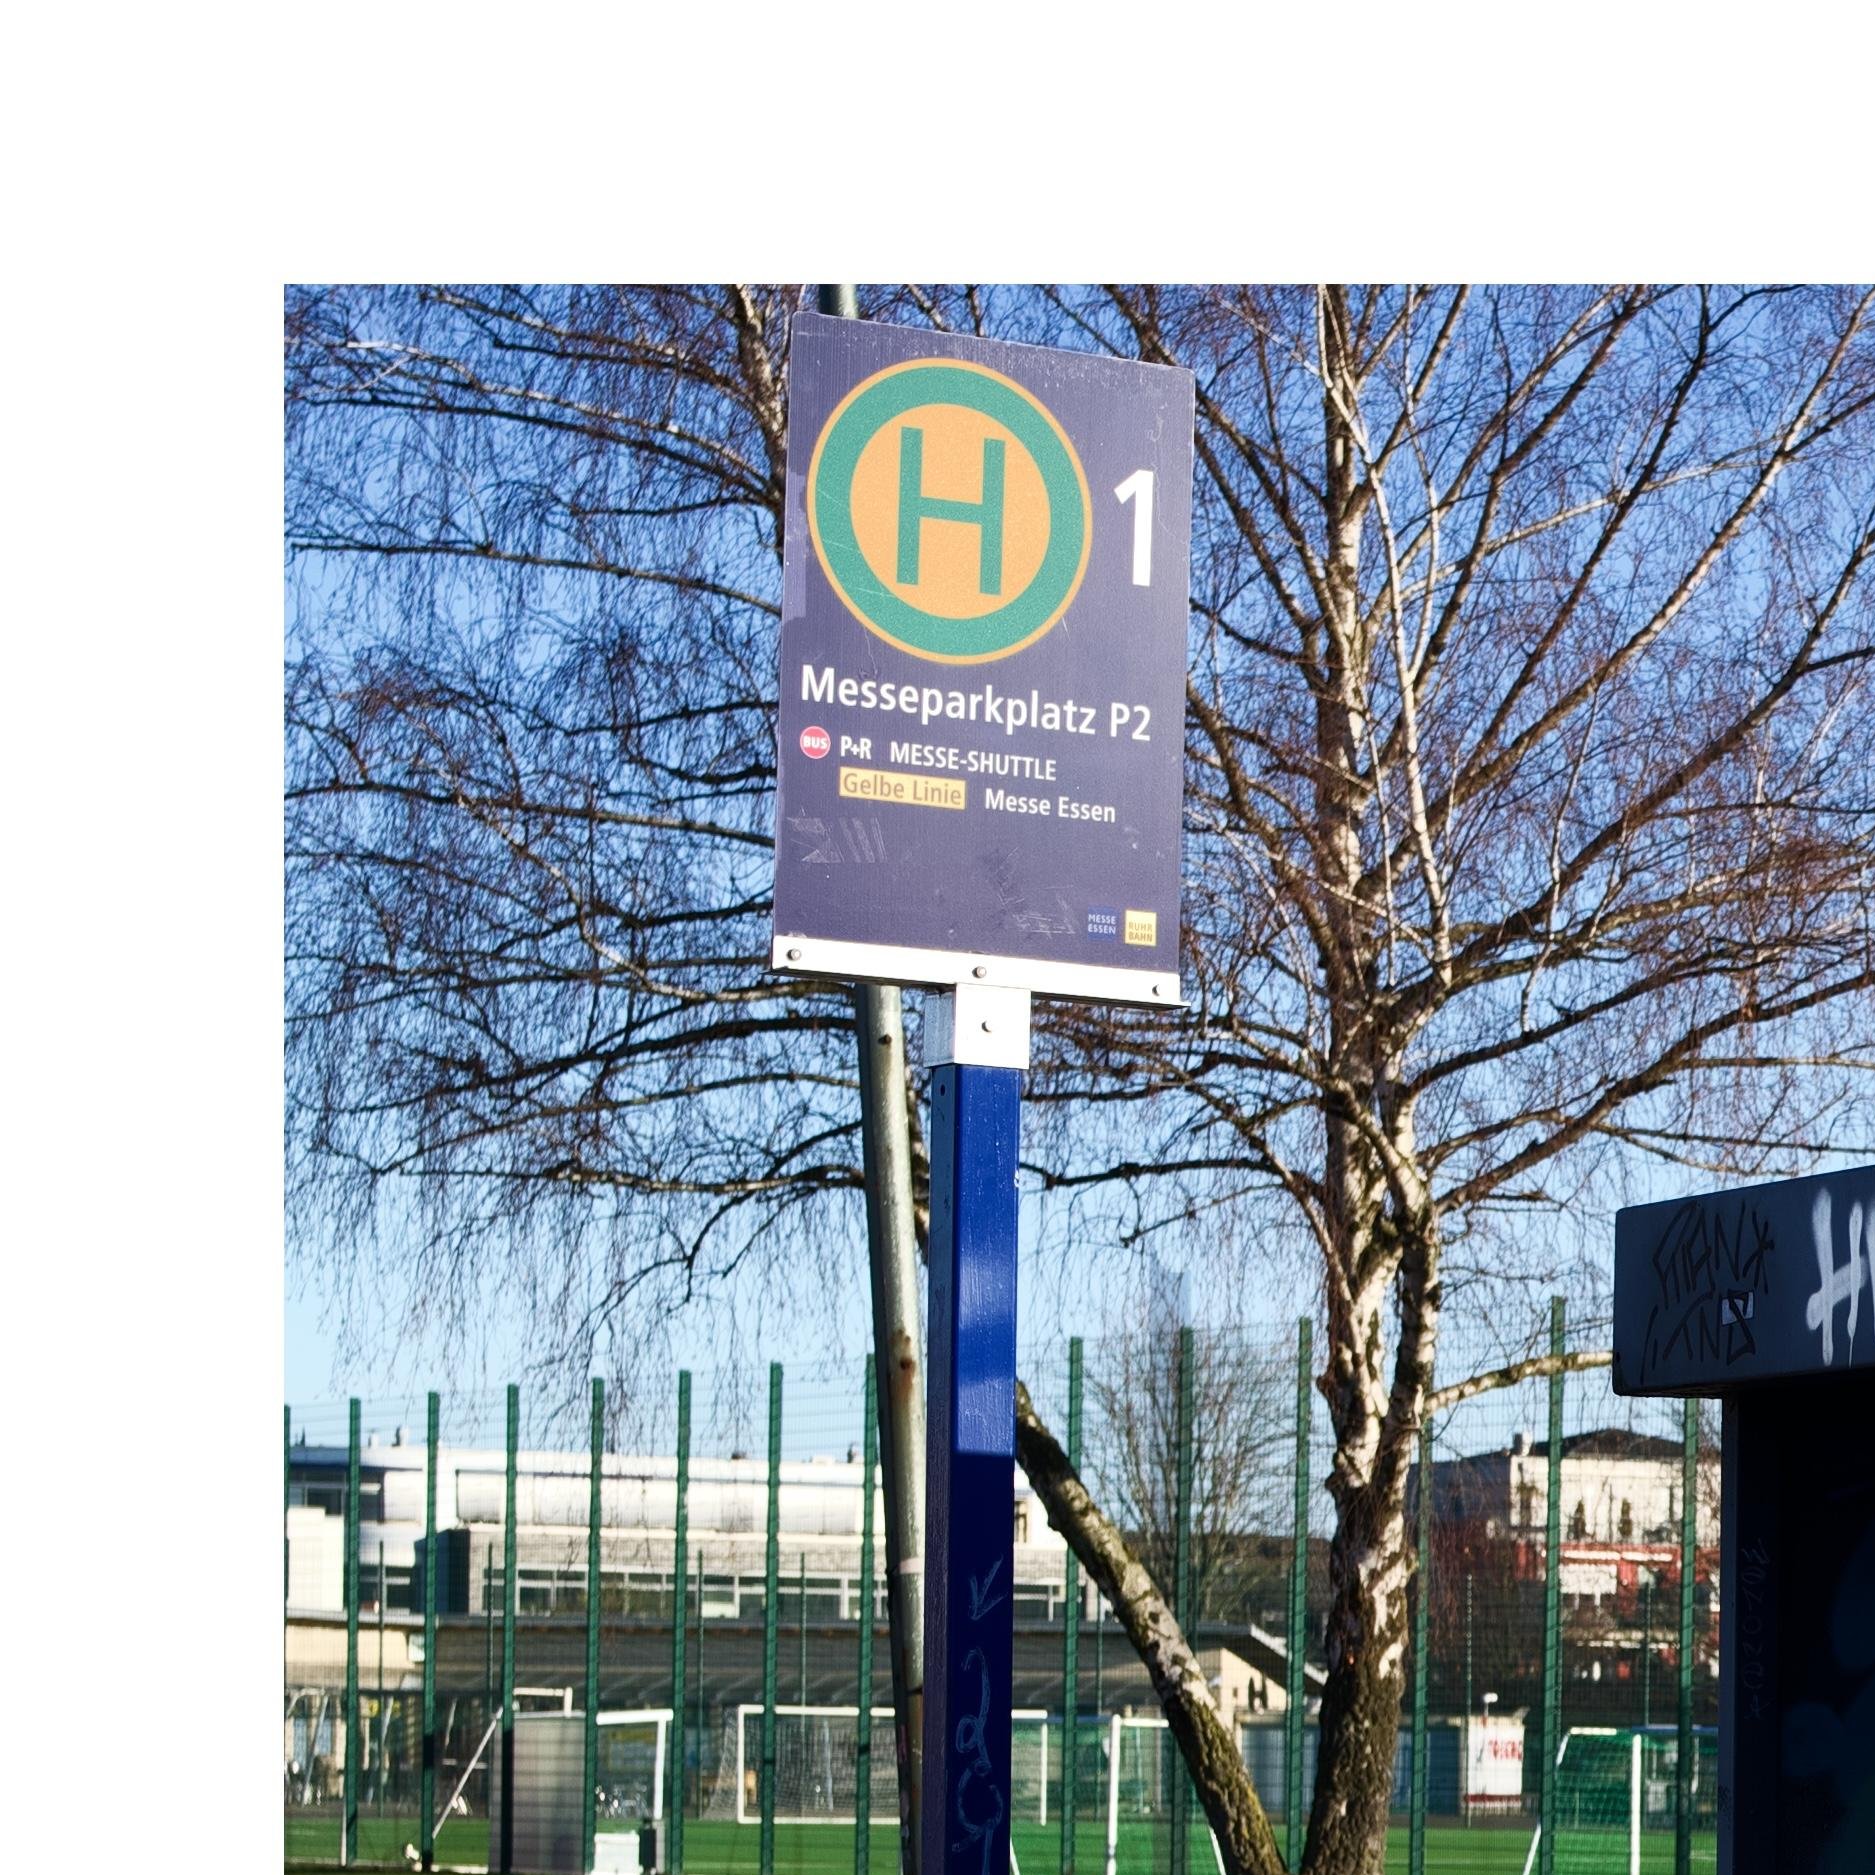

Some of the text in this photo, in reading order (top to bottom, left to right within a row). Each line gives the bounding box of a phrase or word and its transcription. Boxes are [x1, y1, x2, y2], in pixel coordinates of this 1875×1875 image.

[896, 426, 1006, 596] H
[1113, 469, 1155, 588] 1
[801, 664, 1151, 741] Messeparkplatz P2
[802, 735, 1057, 781] BUS P+R MESSE-SHUTTLE
[843, 772, 1116, 823] Gelbe Linie Messe Essen
[1088, 913, 1116, 925] MESSE
[1088, 924, 1116, 935] ESSEN
[1128, 921, 1153, 932] RUHR
[1128, 931, 1153, 942] BAHN
